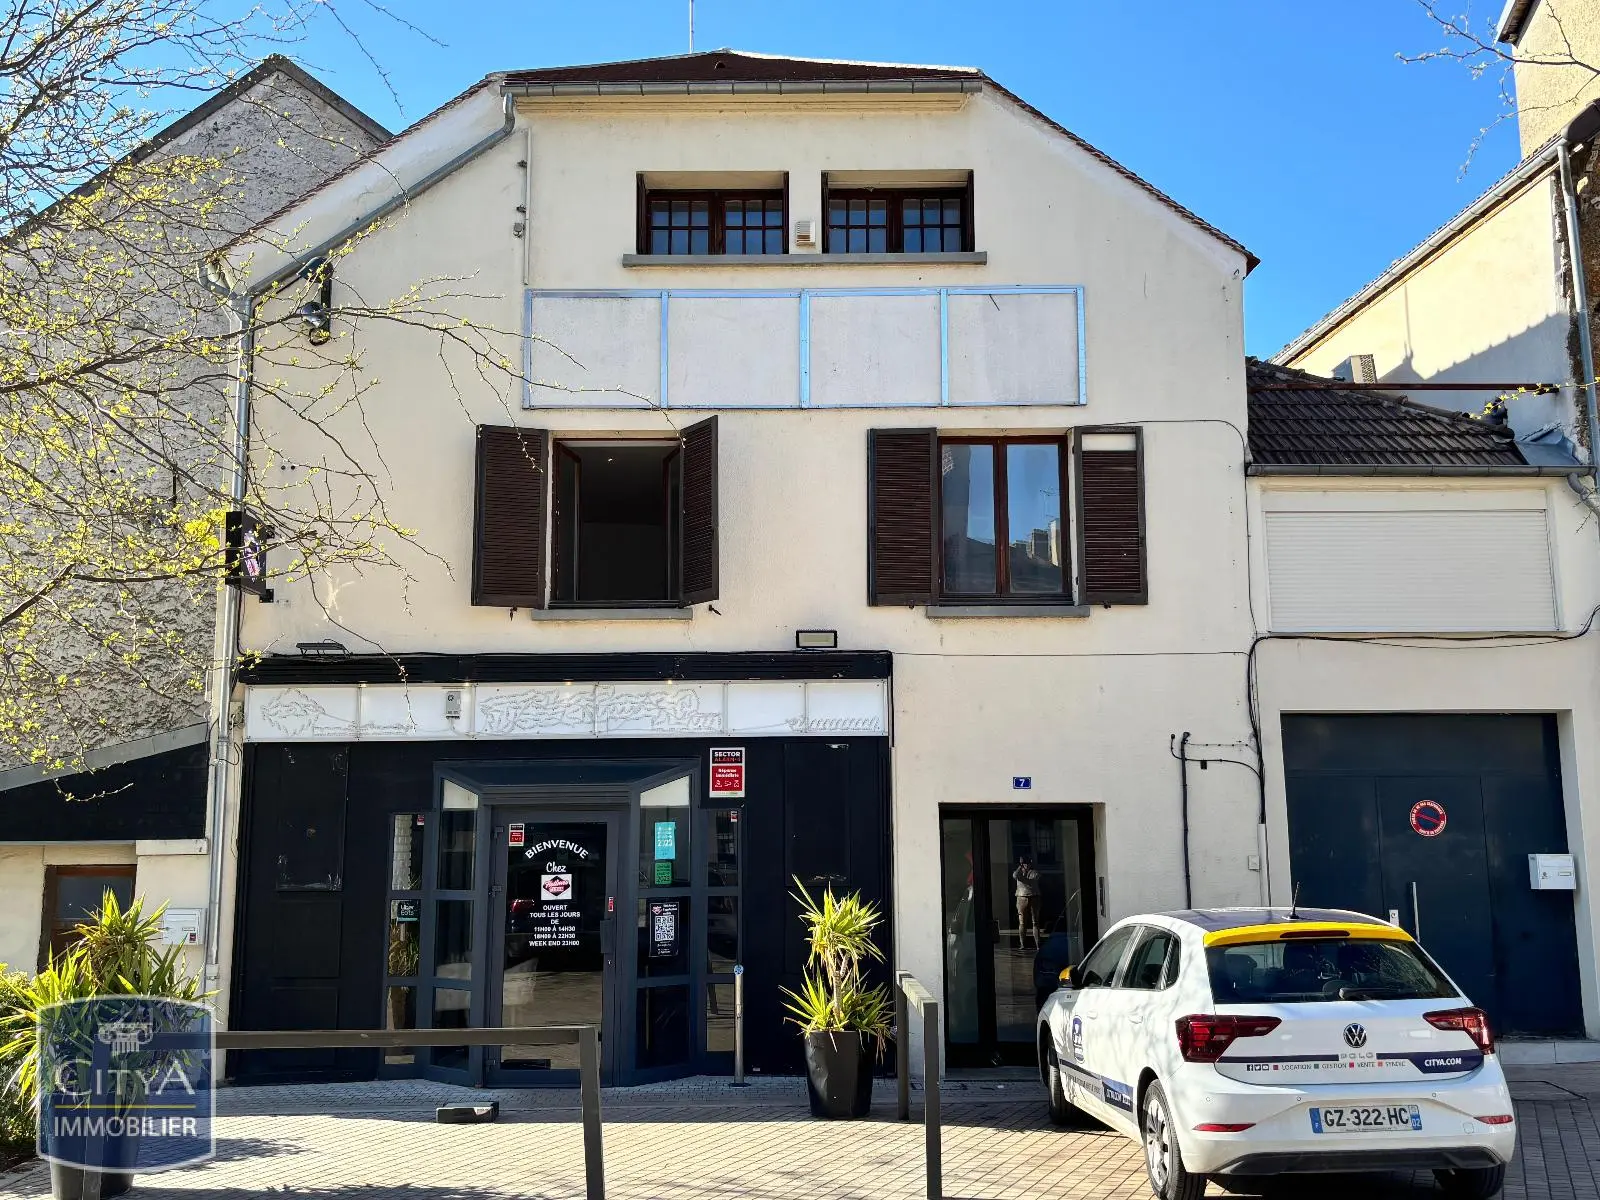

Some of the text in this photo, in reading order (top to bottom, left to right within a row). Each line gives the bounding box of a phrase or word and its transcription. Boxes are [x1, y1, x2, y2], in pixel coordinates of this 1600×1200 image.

[1019, 779, 1025, 787] 7
[525, 840, 589, 859] BIENVENUE
[546, 861, 567, 873] Chez
[1424, 1057, 1462, 1067] CITYA.COM
[1281, 1063, 1312, 1071] LOCATION
[1412, 1118, 1421, 1127] 02
